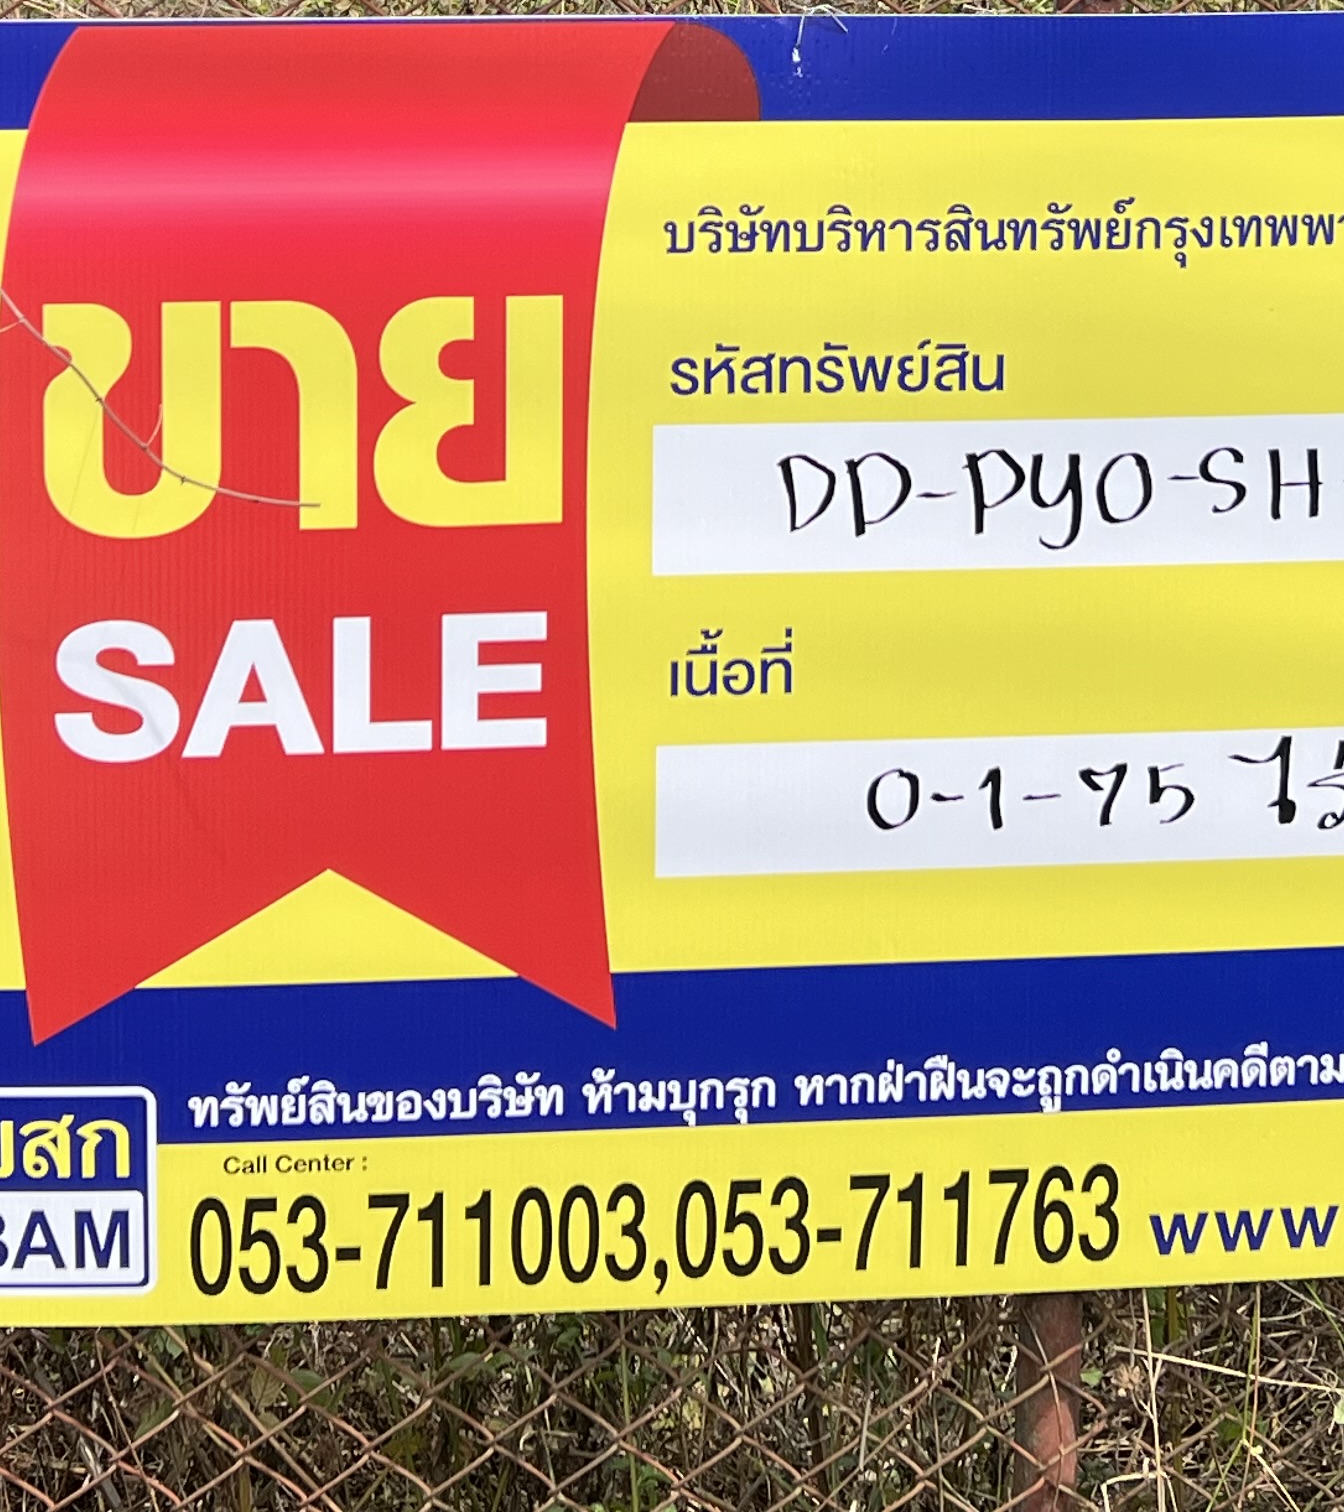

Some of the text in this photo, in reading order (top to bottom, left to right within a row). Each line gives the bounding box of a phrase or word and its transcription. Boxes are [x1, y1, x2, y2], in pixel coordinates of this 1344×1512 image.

[669, 338, 1006, 397] รหัสทรัพย์สิน
[40, 293, 565, 540] ขาย
[53, 610, 549, 764] SALE
[669, 626, 794, 699] เนื้อที่
[866, 761, 1197, 832] 0-1-75
[186, 1070, 565, 1129] ทรัพย์สินของบริษัท
[581, 1066, 777, 1126] ห้ามบุกรุก
[222, 1154, 268, 1176] Call
[274, 1154, 355, 1174] Center
[188, 1161, 1122, 1297] 053-711003,053-711763
